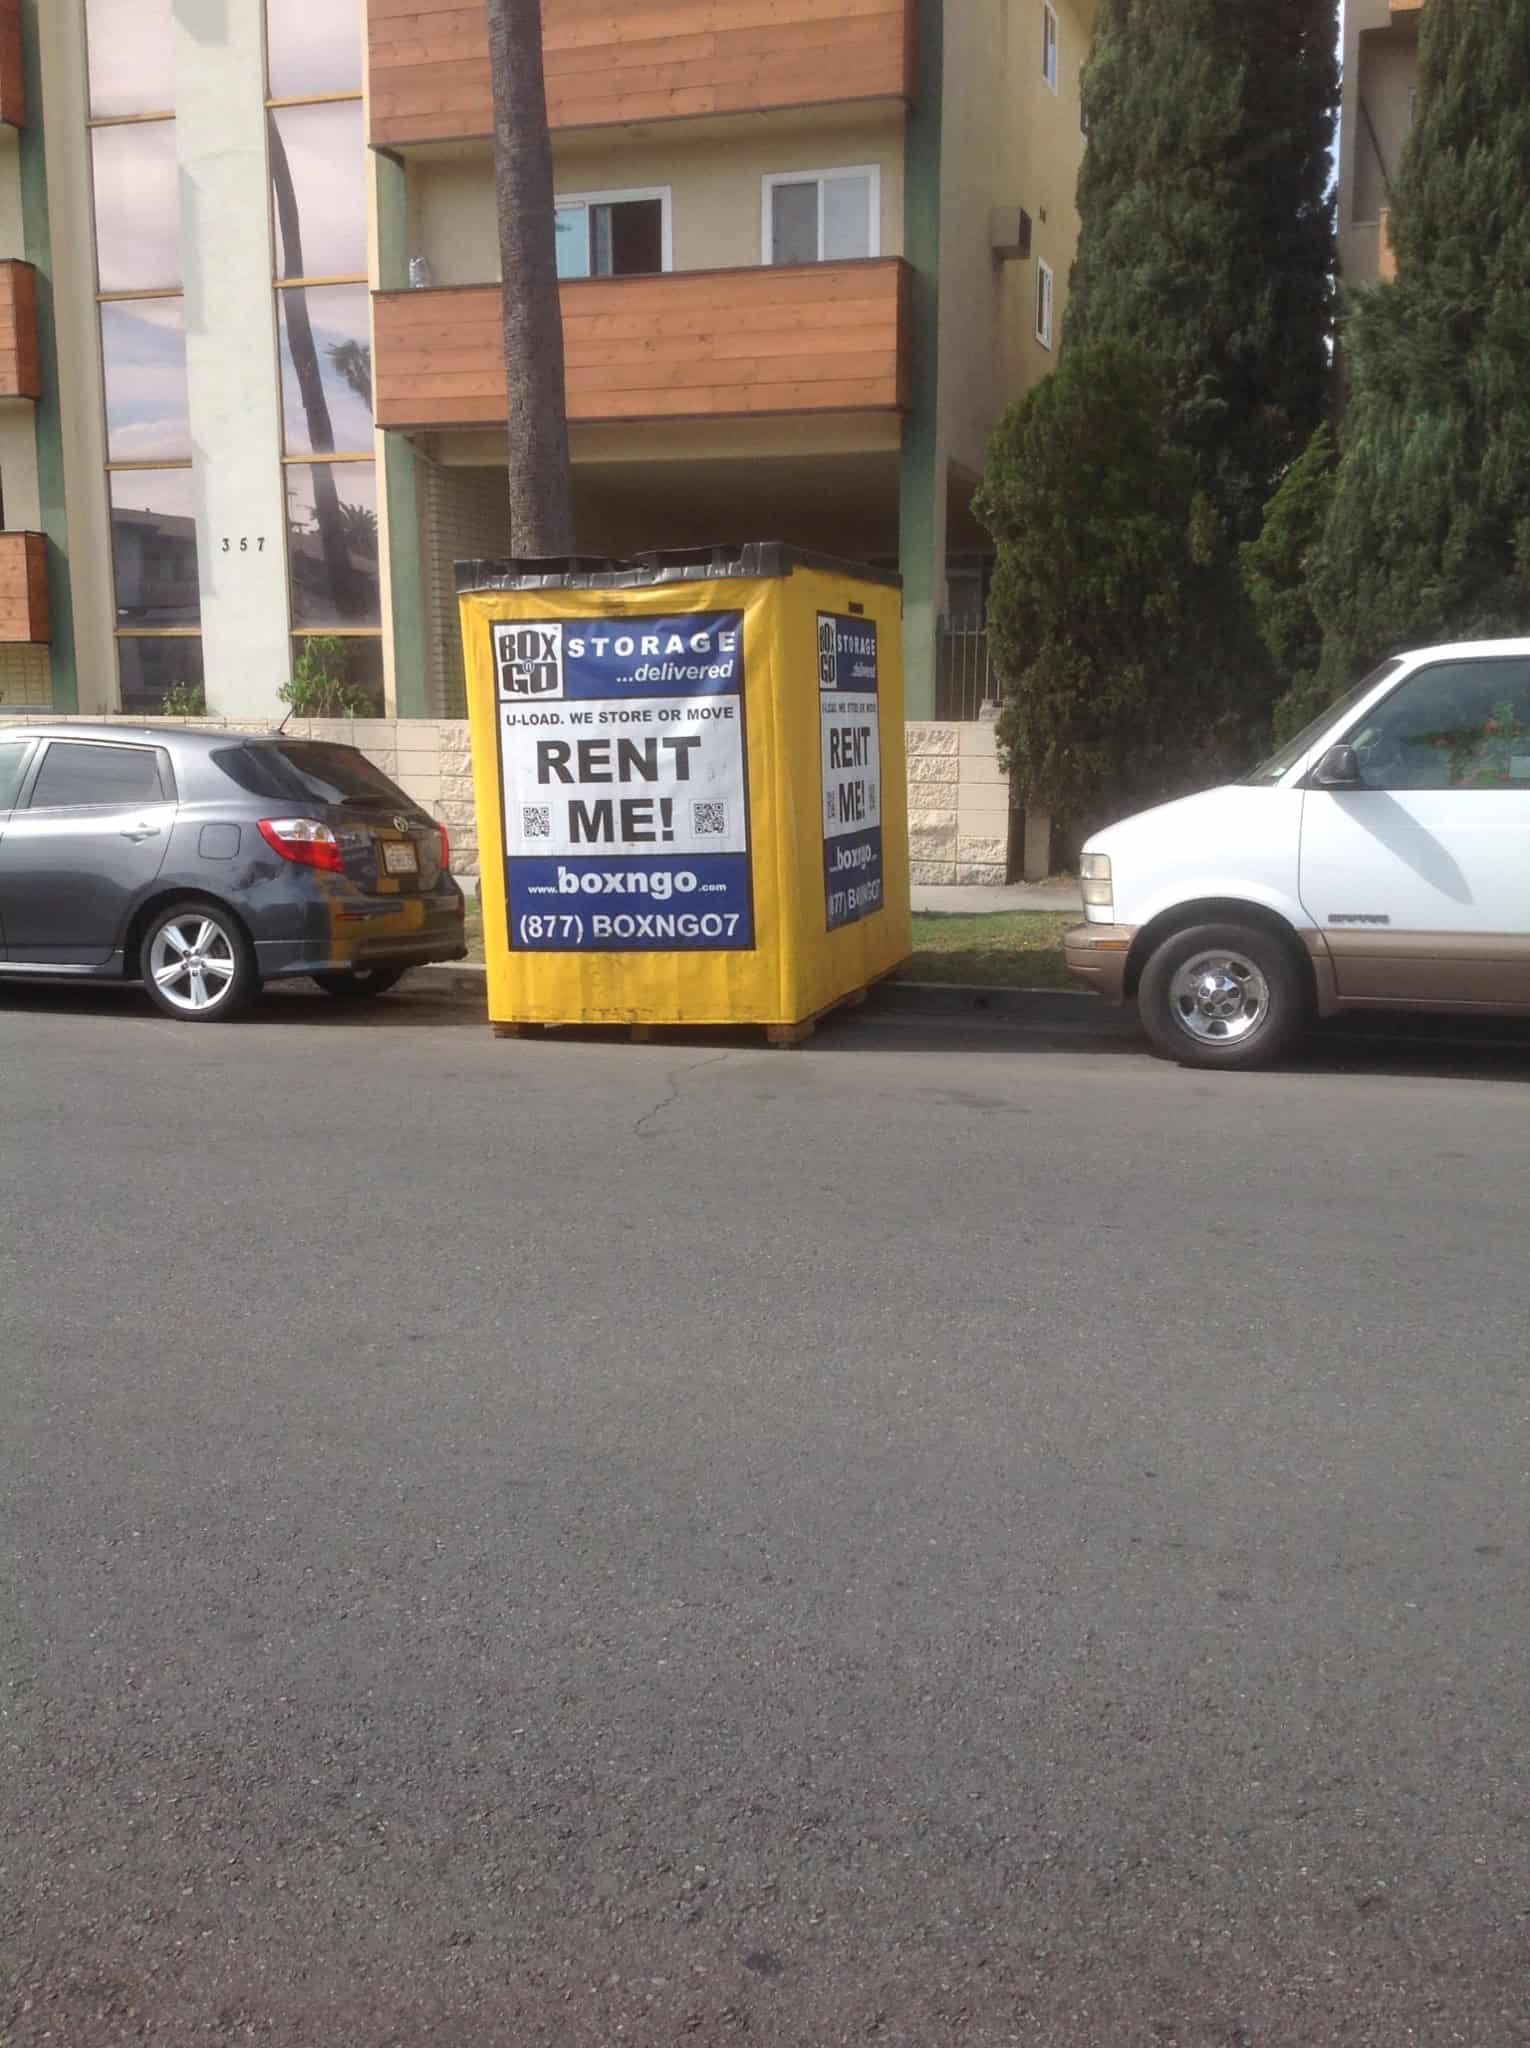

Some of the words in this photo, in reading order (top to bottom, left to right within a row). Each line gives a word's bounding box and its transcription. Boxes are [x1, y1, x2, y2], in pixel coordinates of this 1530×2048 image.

[222, 537, 265, 552] 357
[499, 630, 556, 662] BOX
[568, 631, 736, 658] STORAGE
[837, 634, 875, 656] STORAGE
[503, 662, 557, 694] GO
[616, 660, 733, 683] ...delivered
[506, 715, 564, 726] U-LOAD.
[569, 712, 593, 724] WE
[599, 710, 652, 724] STORE
[658, 709, 681, 721] OR
[687, 707, 734, 720] MOVE
[537, 736, 702, 784] RENT
[830, 727, 870, 768] RENT
[839, 780, 865, 824] ME!
[568, 798, 674, 843] ME!
[520, 914, 584, 943] (877)
[592, 913, 740, 939] BOXNGO7
